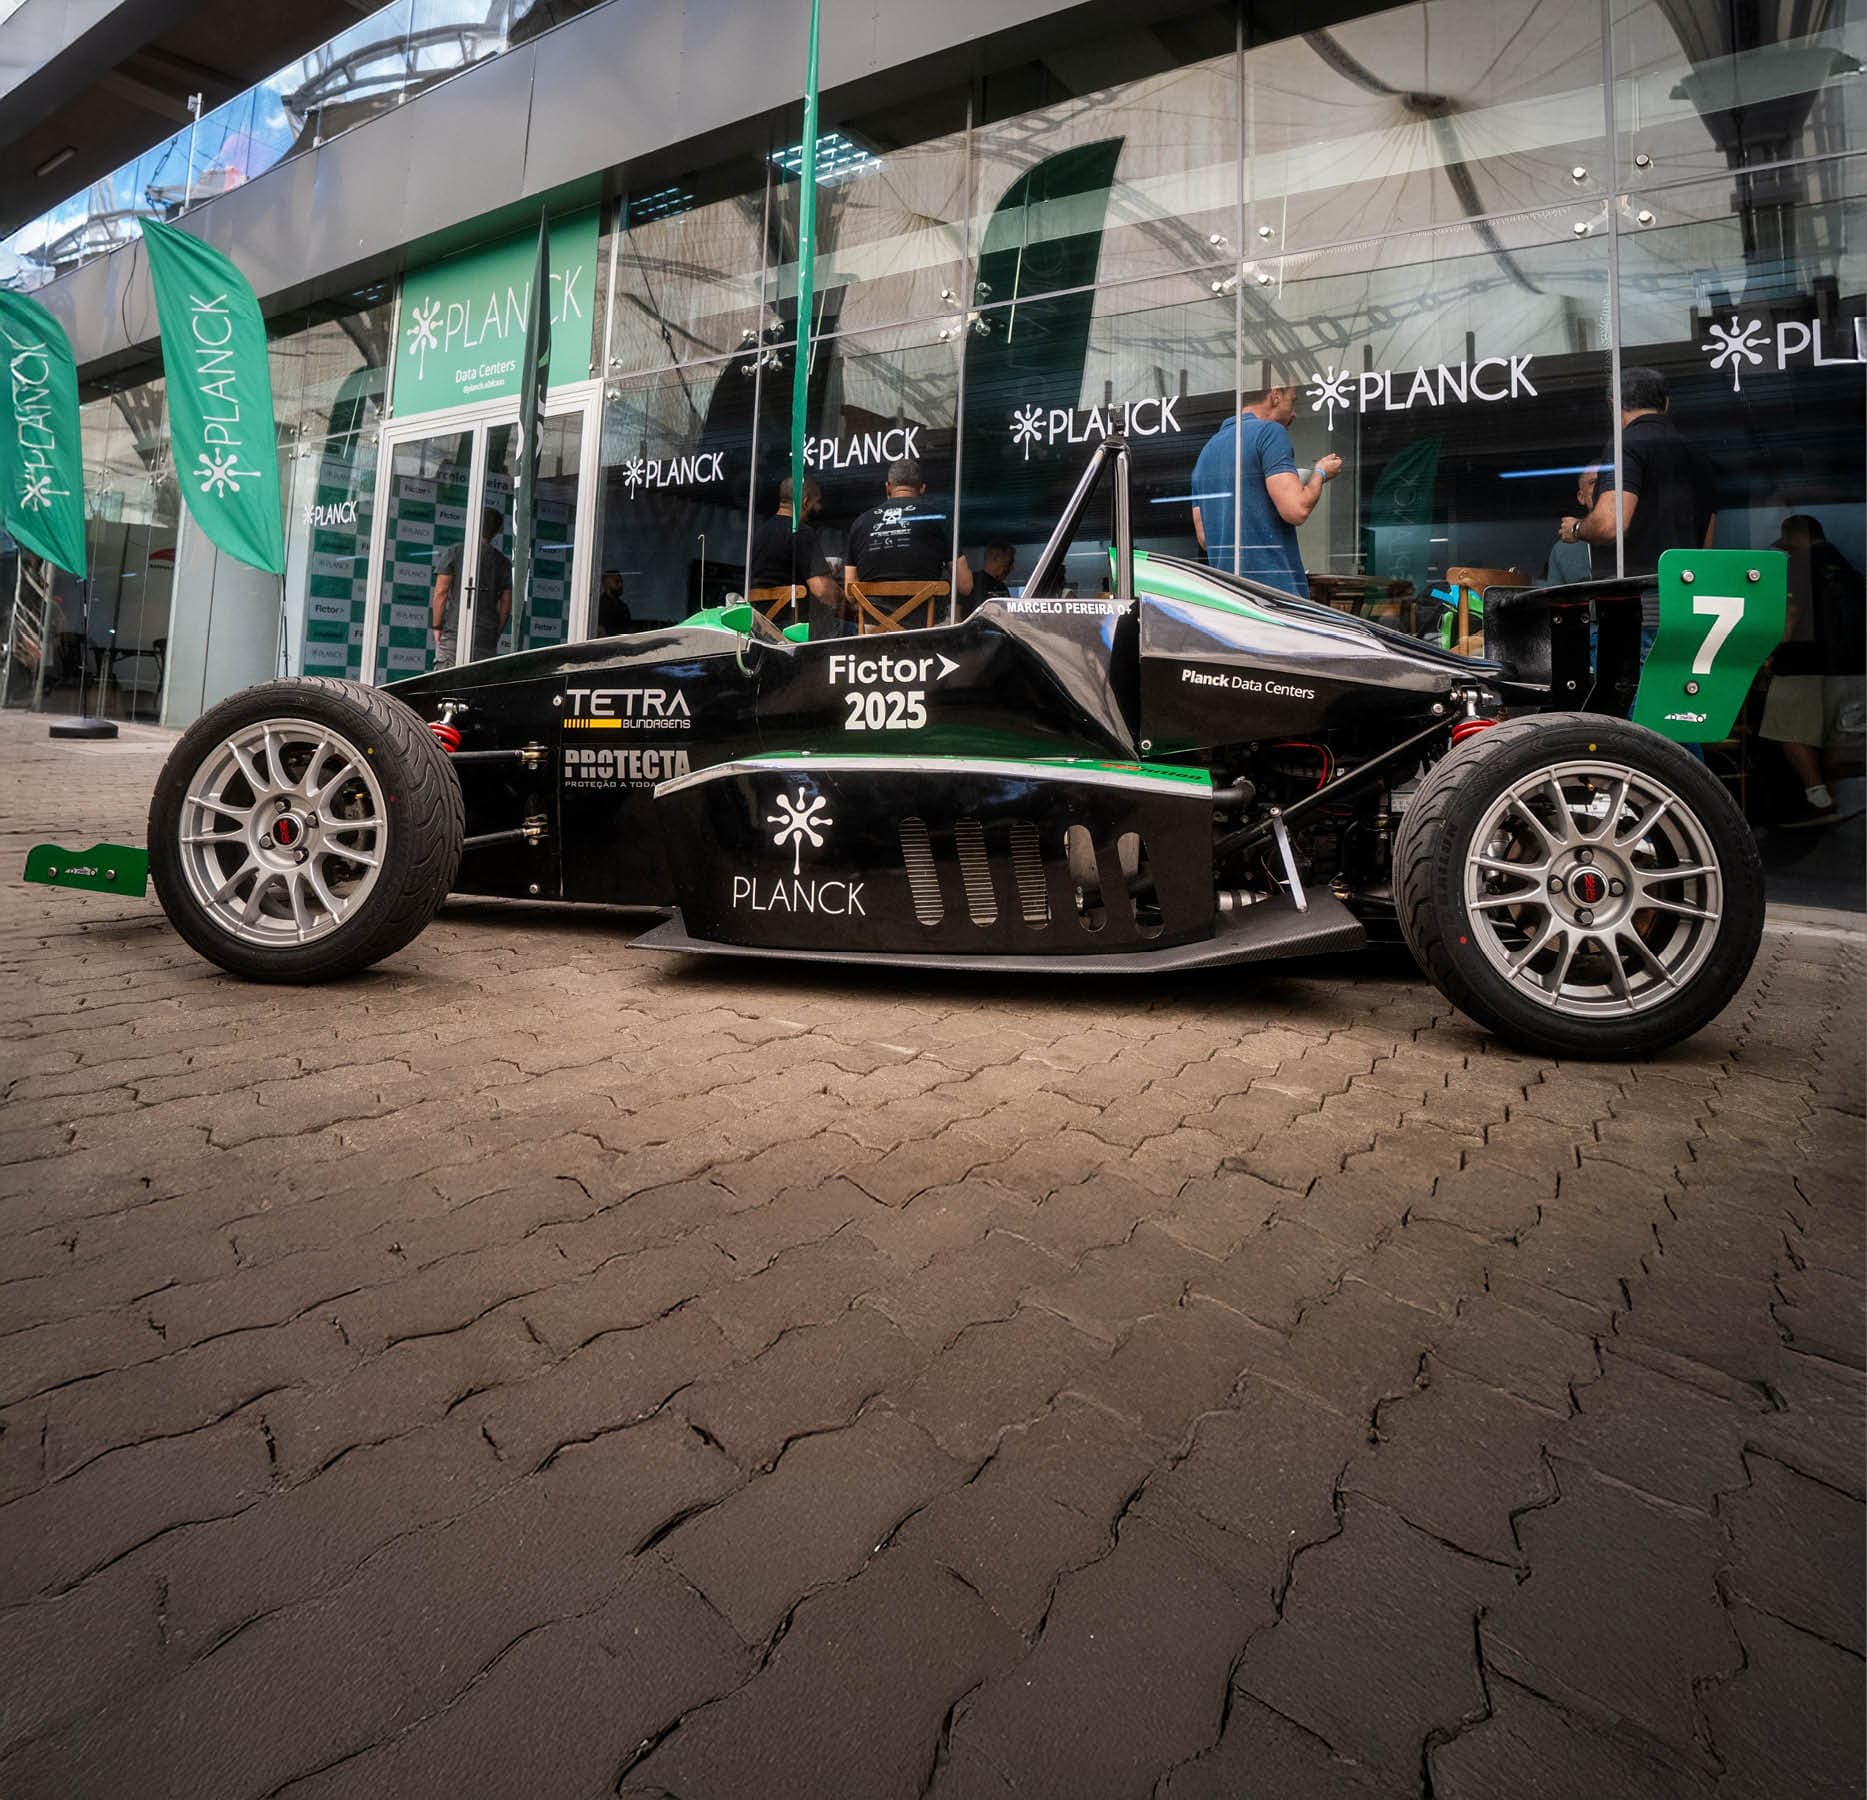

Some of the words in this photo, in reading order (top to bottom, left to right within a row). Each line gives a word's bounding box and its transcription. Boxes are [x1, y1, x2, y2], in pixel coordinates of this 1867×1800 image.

[445, 265, 582, 353] PLANK
[189, 293, 242, 445] PLANCK
[455, 366, 477, 384] Data
[479, 359, 517, 377] Centers
[1360, 353, 1538, 413] PLANCK
[819, 425, 920, 470] PLANCK
[645, 451, 725, 489] PLANCK
[314, 500, 358, 527] PLANCK
[315, 604, 339, 614] Fictor
[1007, 602, 1063, 614] MARCELO
[1065, 602, 1114, 615] PEREIRA
[1692, 595, 1744, 674] 7
[829, 654, 934, 685] Fictor
[1181, 668, 1230, 688] Planck
[1231, 676, 1262, 692] Data
[1265, 681, 1316, 700] Centers
[566, 688, 692, 716] TETRA
[844, 691, 927, 730] 2025
[622, 719, 691, 729] BLINDAGENS
[564, 749, 691, 779] PROTECTA
[564, 779, 617, 789] PROTEÇÃO
[733, 876, 866, 916] PLANCK
